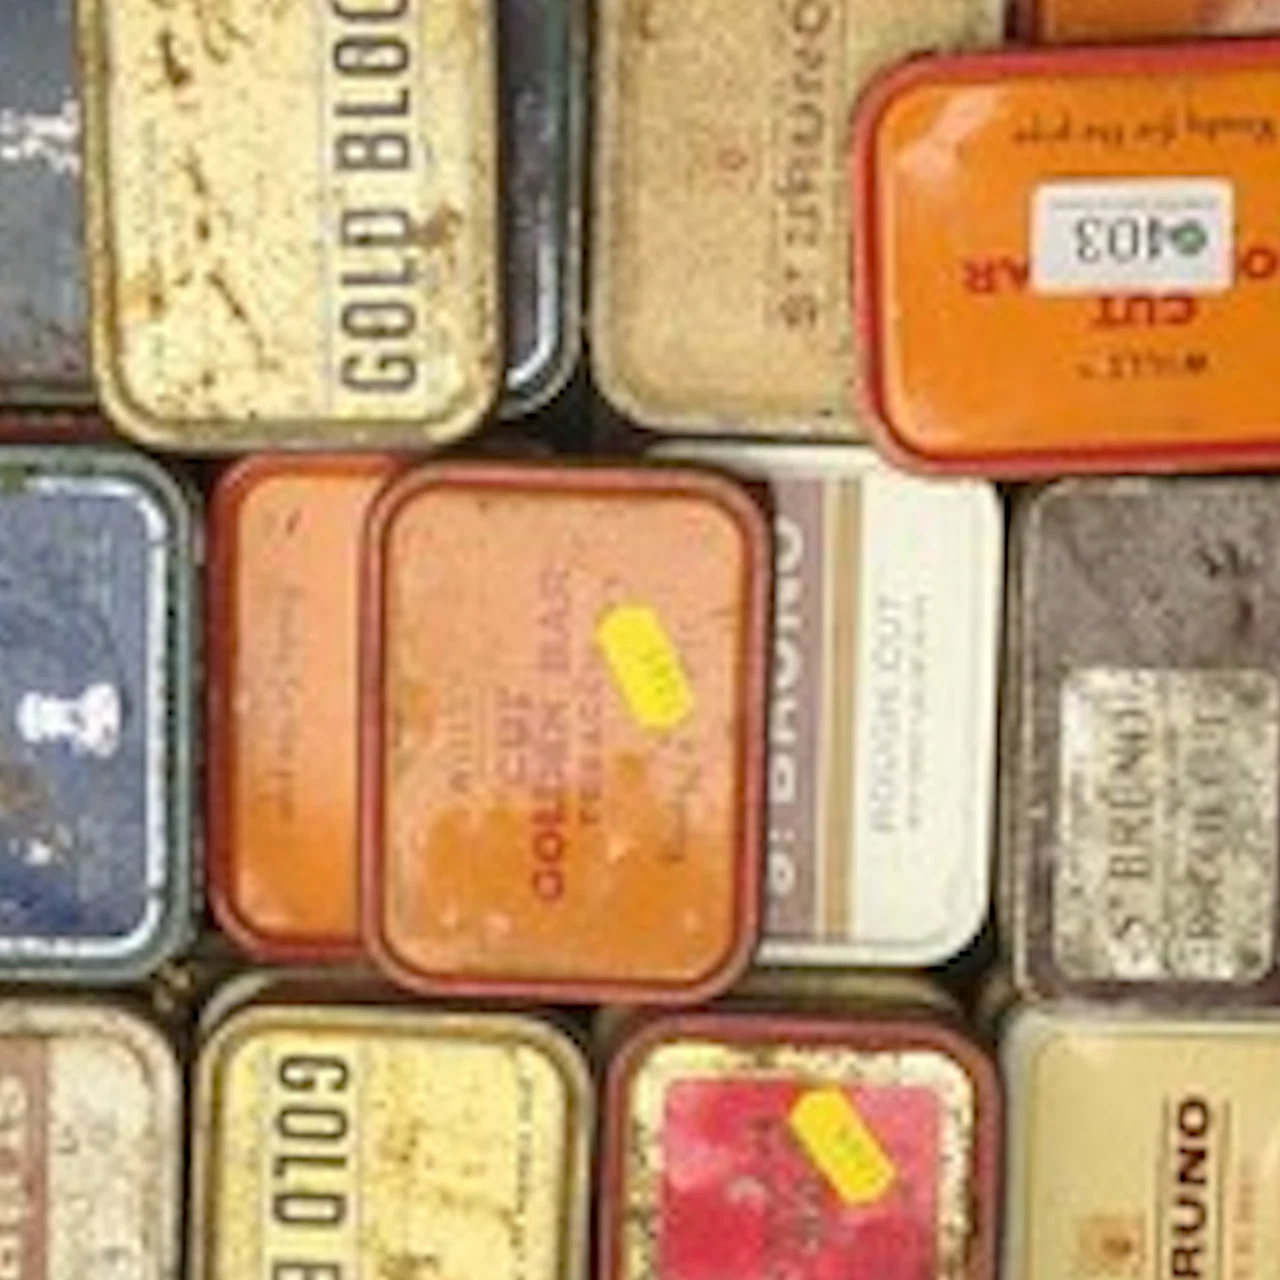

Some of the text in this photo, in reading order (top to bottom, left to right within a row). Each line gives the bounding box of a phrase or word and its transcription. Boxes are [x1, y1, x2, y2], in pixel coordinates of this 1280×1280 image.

[340, 206, 417, 395] GOLD
[878, 593, 907, 673] CUT
[531, 567, 573, 903] GOLDEN BAR
[273, 1054, 350, 1228] GOLD
